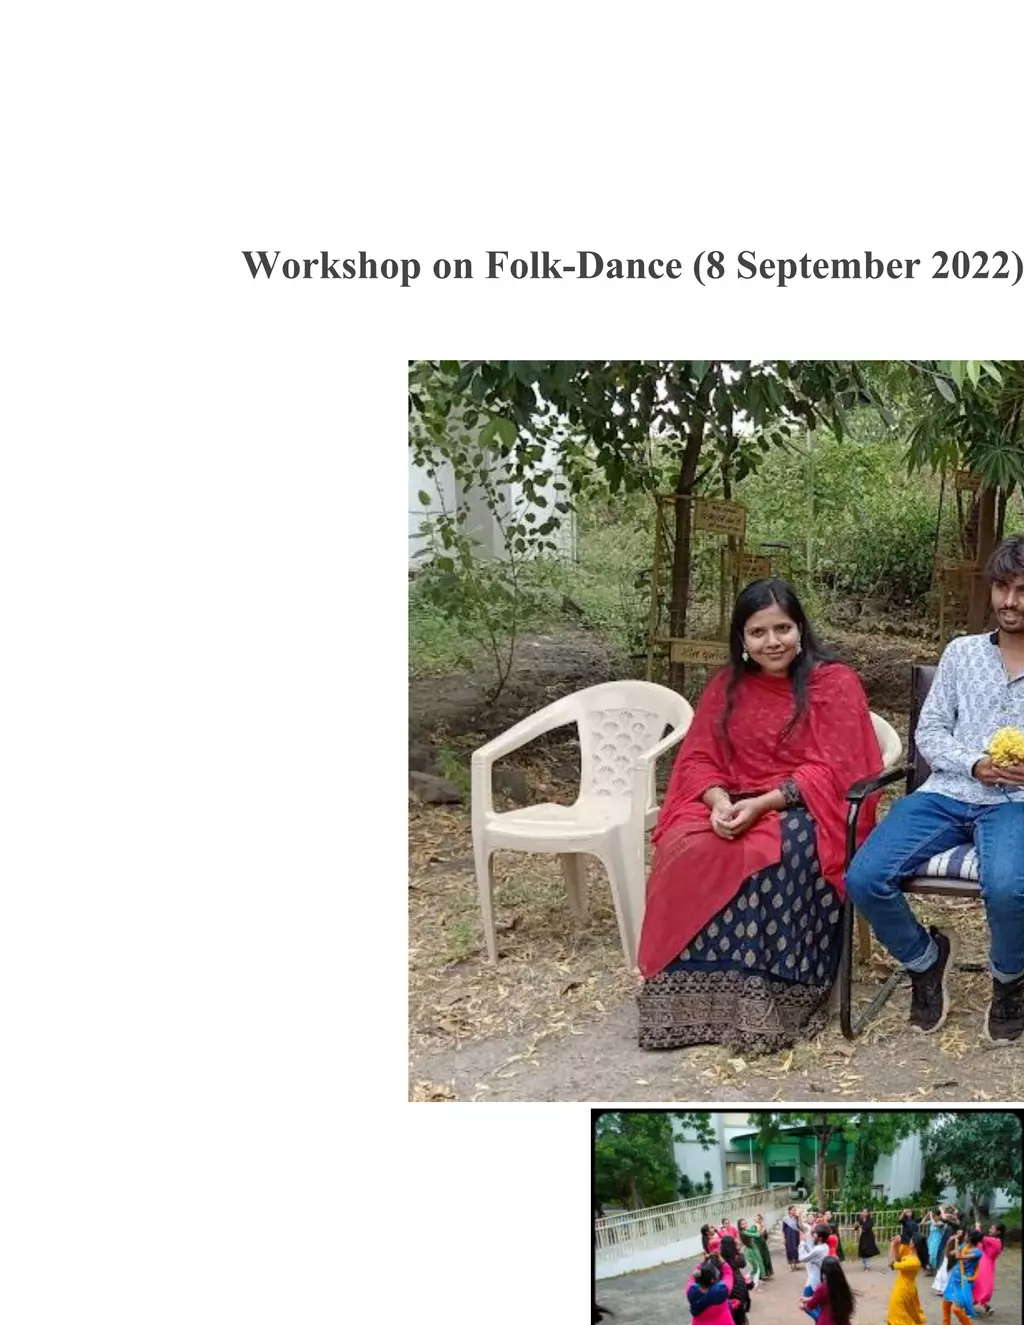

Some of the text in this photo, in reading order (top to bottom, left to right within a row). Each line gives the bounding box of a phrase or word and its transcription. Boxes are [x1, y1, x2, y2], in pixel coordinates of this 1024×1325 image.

[242, 251, 1023, 287] Workshop on Folk-Dance (8 September 2022)
